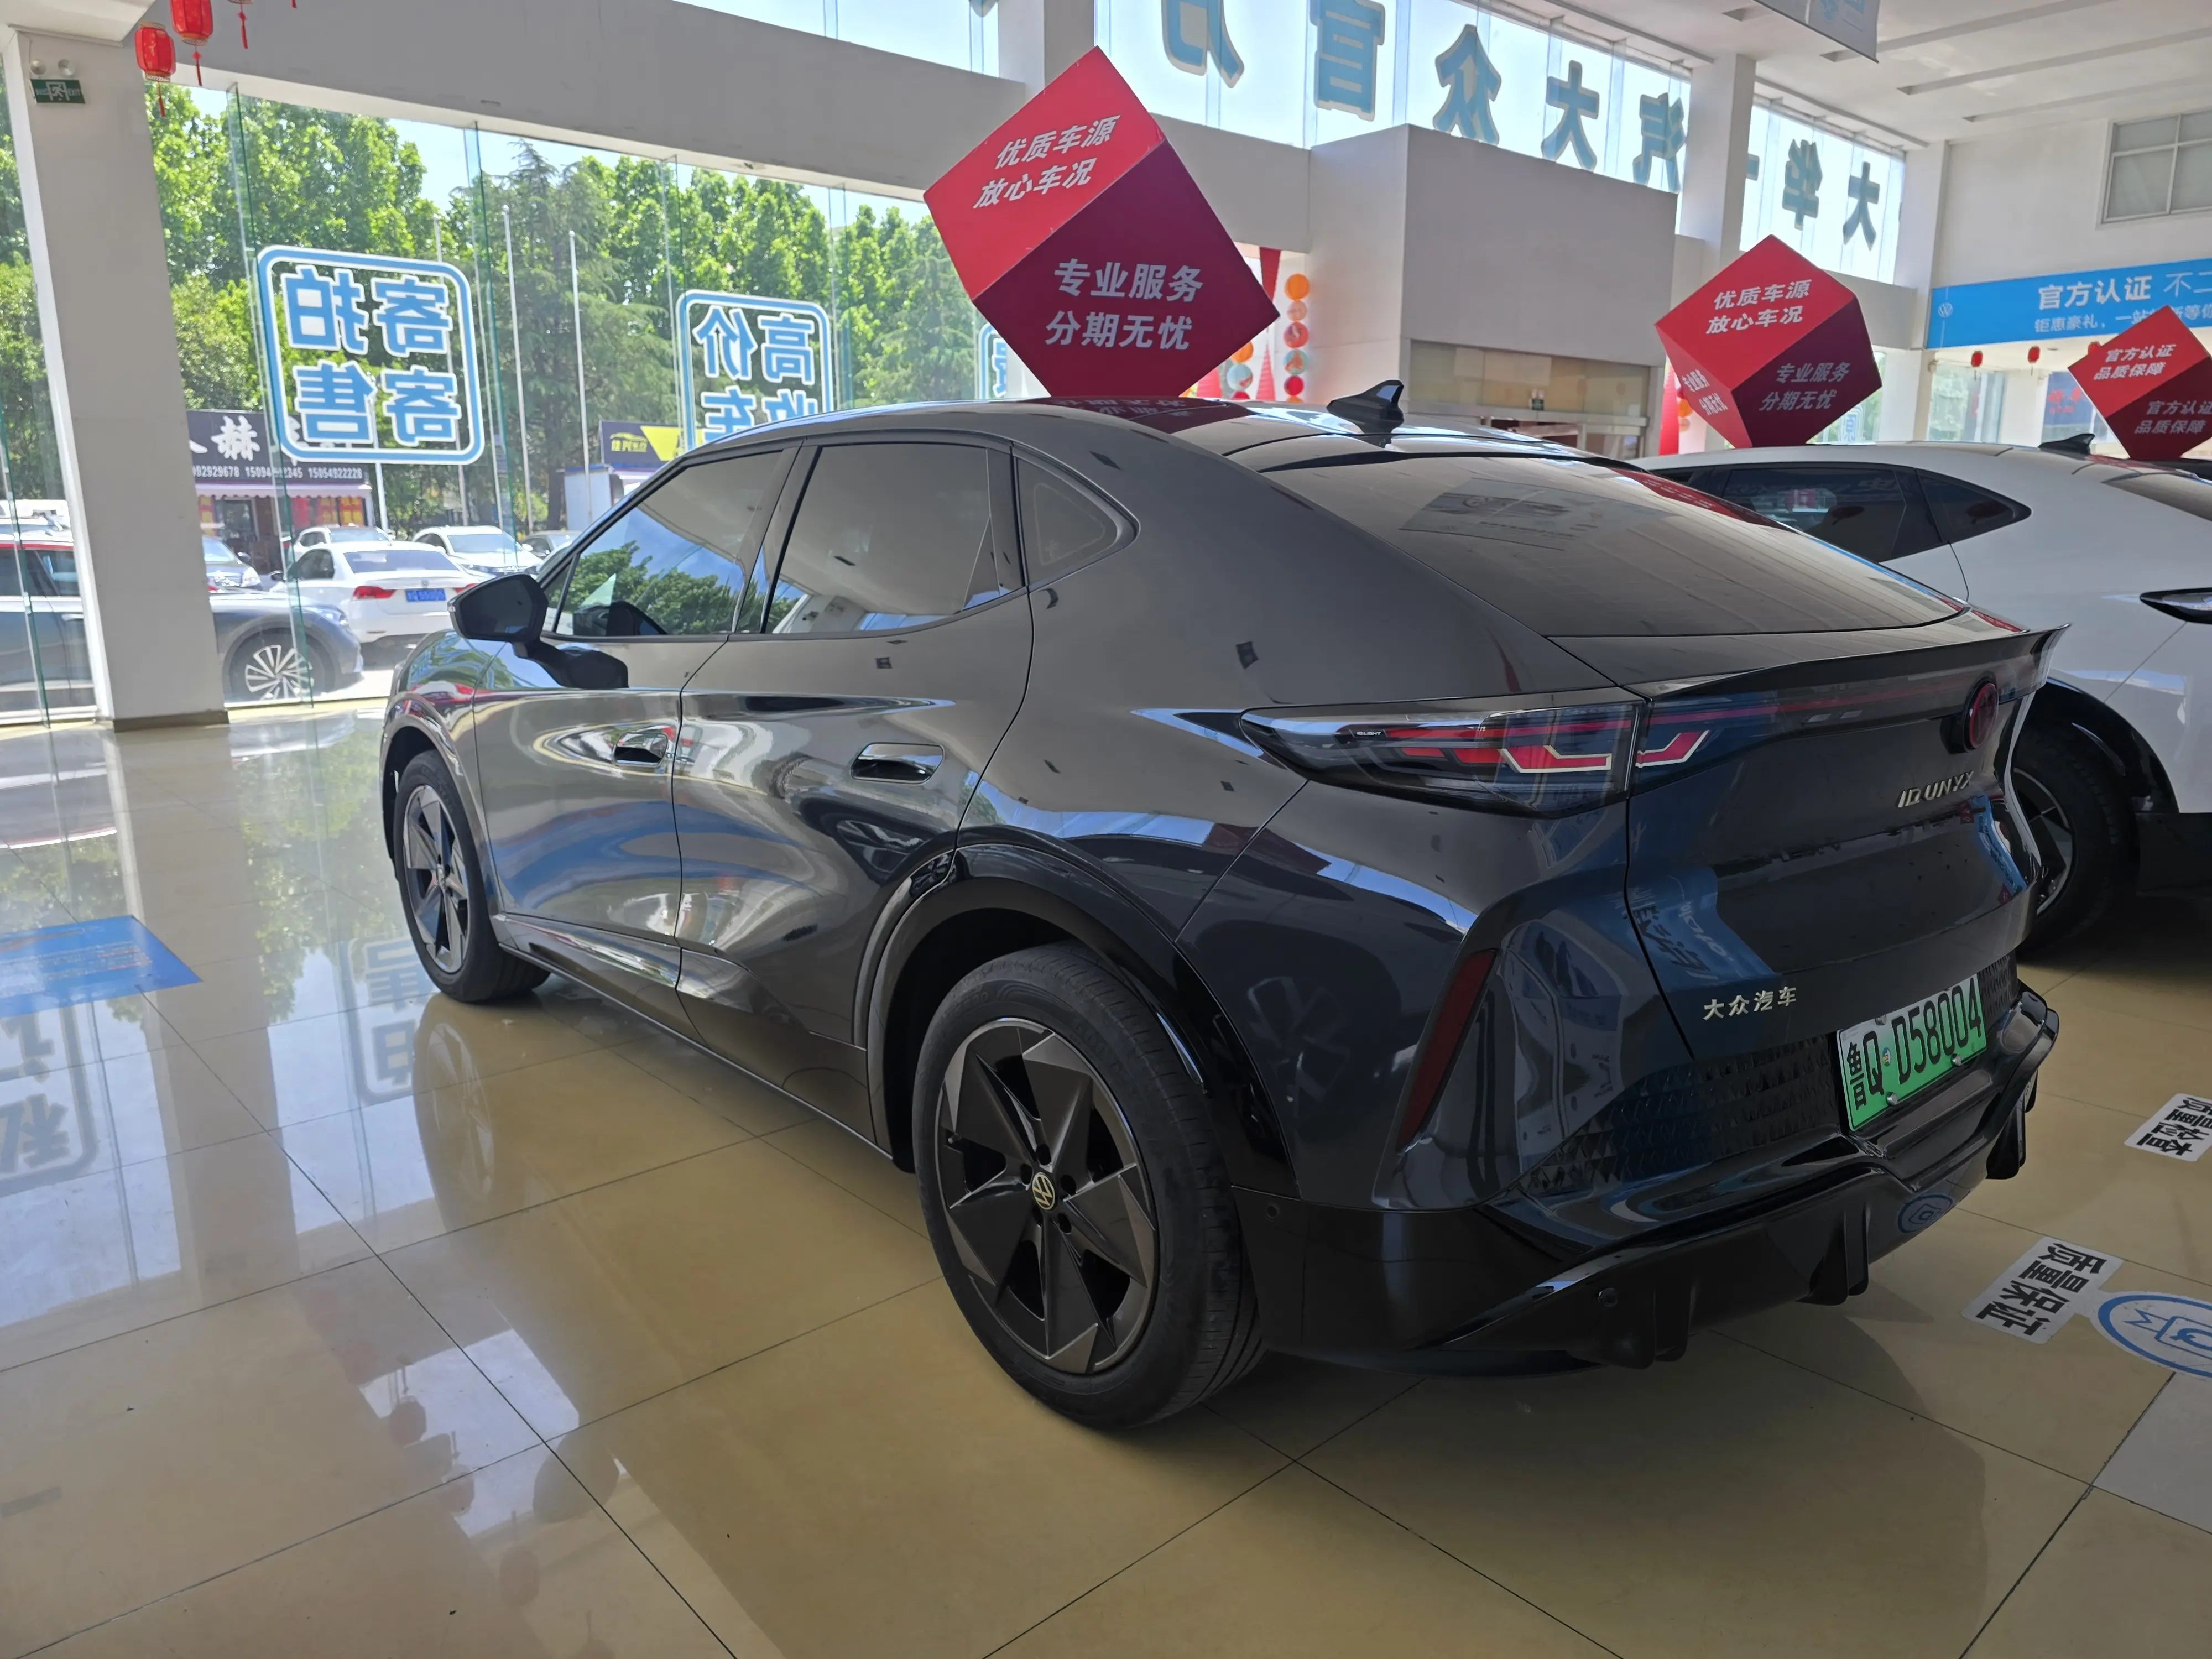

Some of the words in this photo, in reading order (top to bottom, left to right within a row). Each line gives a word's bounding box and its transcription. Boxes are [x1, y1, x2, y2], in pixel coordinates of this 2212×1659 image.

[995, 114, 1120, 169] 优质车源
[973, 158, 1097, 210] 放心车况
[1054, 258, 1204, 302] 专业服务
[1714, 279, 1812, 310] 优质车源
[2038, 275, 2152, 310] 官方认证
[1045, 310, 1193, 350] 分期无忧
[1706, 306, 1803, 334] 放心车况
[2105, 344, 2176, 363] 官方认证
[1776, 362, 1851, 384] 专业服务
[2094, 362, 2166, 380] 品质保障
[1759, 389, 1838, 411] 分期无忧
[2146, 400, 2212, 415] 官方认证
[2134, 419, 2207, 434] 品质保障
[1703, 985, 1797, 1021] 大众汽车
[1975, 1242, 2107, 1337] 质量保证
